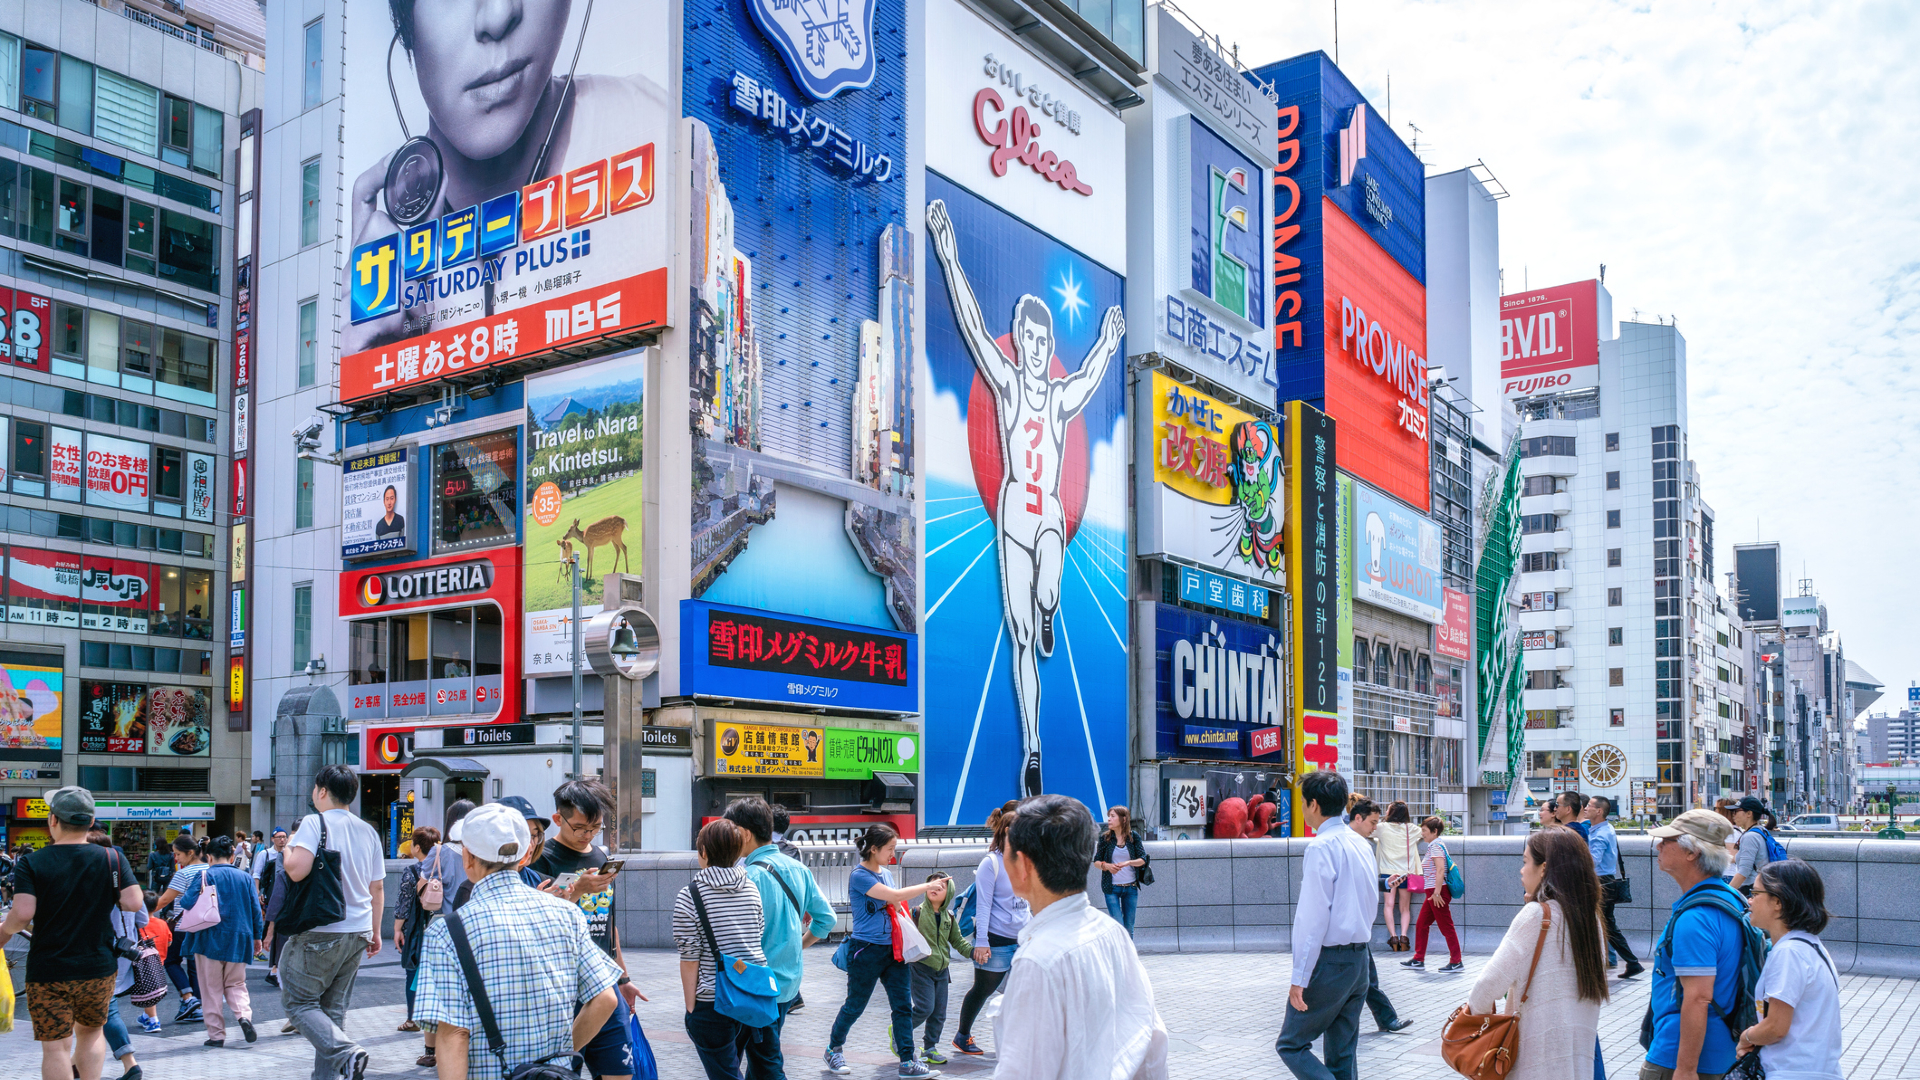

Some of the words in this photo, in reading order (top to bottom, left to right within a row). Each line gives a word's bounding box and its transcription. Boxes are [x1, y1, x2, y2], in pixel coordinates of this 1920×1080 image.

[1191, 41, 1252, 105] 夢ある住まい
[984, 53, 1082, 136] おいしさと健康
[1181, 66, 1262, 145] エステムシリーズ
[732, 69, 892, 182] 雪印メグミルク
[972, 87, 1094, 197] Glico
[403, 257, 507, 310] SATURDAY
[515, 237, 568, 276] PLUS
[31, 296, 48, 308] 5F
[545, 291, 621, 345] MBS
[1503, 299, 1525, 308] Since
[372, 318, 519, 389] 土曜あさ8時
[1166, 294, 1280, 390] 日商エステム
[1342, 295, 1428, 408] PROMISE
[1504, 373, 1571, 395] FUJIBO
[1165, 386, 1224, 434] かぜに
[1397, 398, 1428, 442] プロミス
[532, 422, 581, 450] Travel
[584, 427, 595, 440] to
[598, 415, 638, 438] Nara
[532, 466, 546, 478] on
[548, 447, 623, 475] Kintetsu.
[1023, 415, 1045, 516] グリコ
[1160, 422, 1229, 490] 改源
[110, 470, 148, 498] 0円
[539, 497, 554, 513] 35
[82, 566, 142, 603] 風月
[387, 564, 486, 598] LOTTERIA
[1186, 572, 1265, 613] 戸堂歯科
[1389, 556, 1433, 601] WAON
[10, 612, 24, 622] AM
[709, 619, 907, 680] 雪印メグミルク牛乳
[787, 682, 839, 698] 雪印メグミルク
[1171, 634, 1284, 726] CHINTAI
[393, 691, 426, 707] 完全分煙
[126, 739, 143, 751] 2F
[477, 729, 512, 743] Toilets
[743, 730, 800, 747] 店舗情報館
[857, 735, 895, 764] ピタットハウス
[1262, 731, 1278, 750] 検索
[0, 769, 38, 780] STATION
[728, 764, 753, 774] 株式会社
[755, 765, 791, 775] 関西インベスト
[126, 808, 172, 818] FamilyMart
